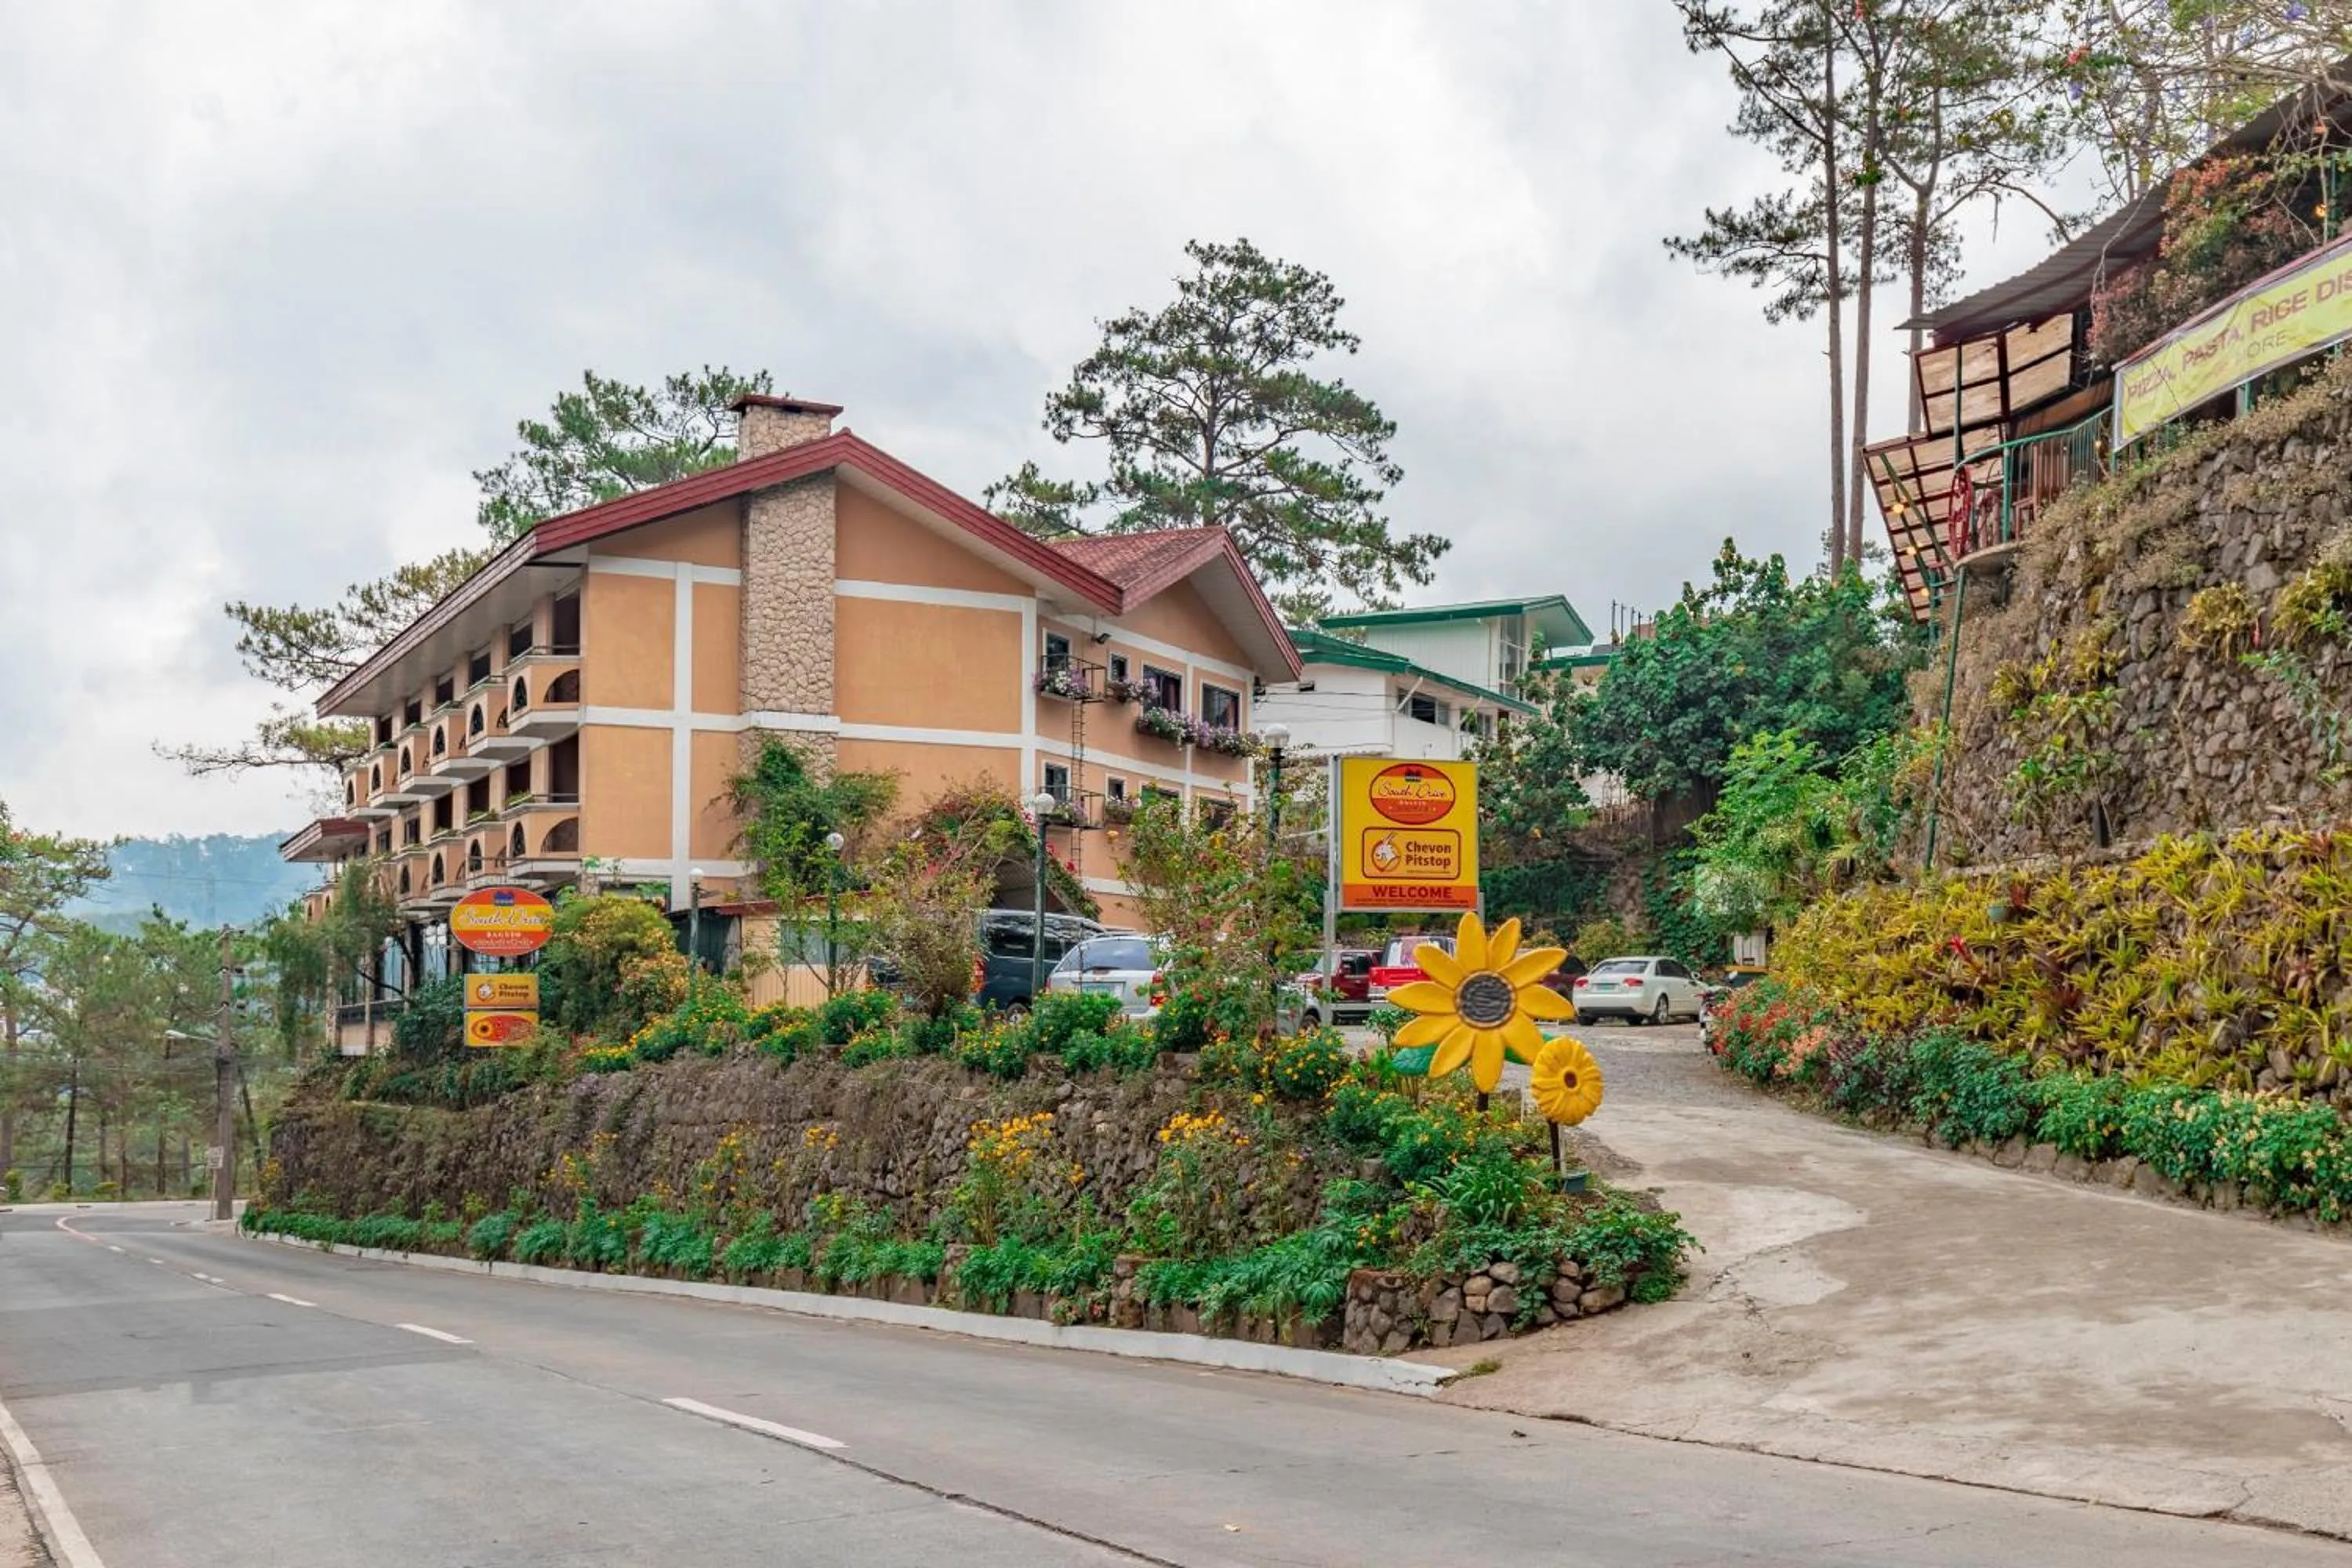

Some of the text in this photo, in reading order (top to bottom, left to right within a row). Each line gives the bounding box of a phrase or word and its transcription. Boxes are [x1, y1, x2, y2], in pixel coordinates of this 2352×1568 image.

[2251, 289, 2308, 333] RICE
[1378, 781, 1446, 798] South Drive
[1406, 840, 1451, 854] Chevon
[1406, 854, 1451, 869] Pitstop
[1373, 885, 1452, 898] WELCOME
